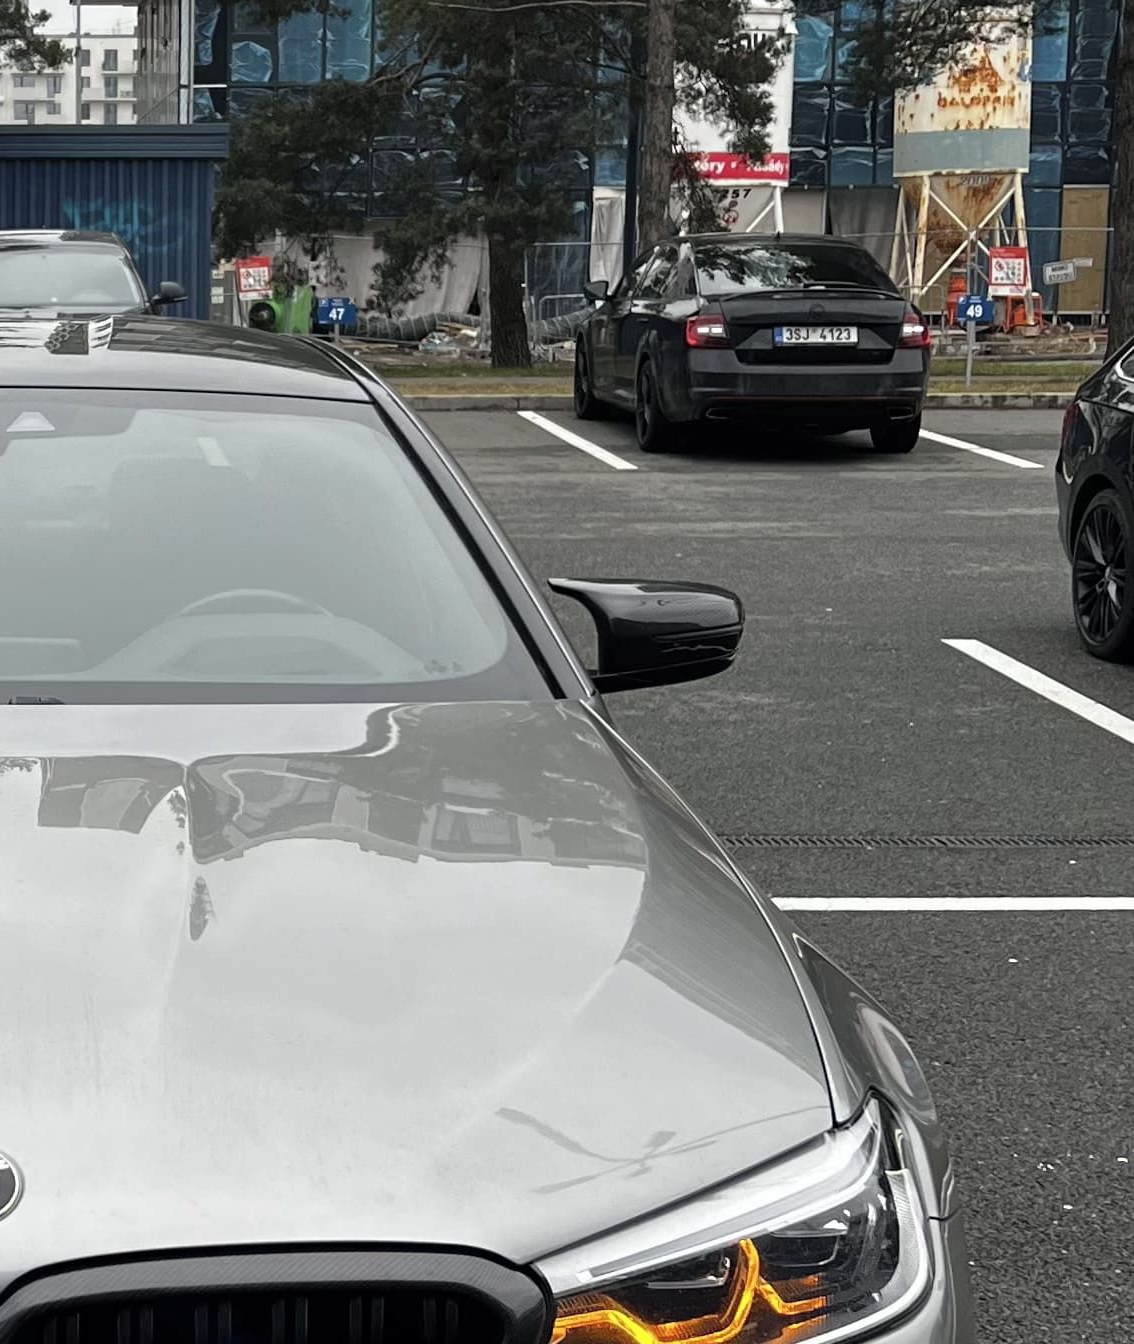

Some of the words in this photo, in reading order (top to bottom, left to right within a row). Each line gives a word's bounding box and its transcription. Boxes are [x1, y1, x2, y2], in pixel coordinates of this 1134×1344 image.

[328, 307, 345, 320] 47
[966, 304, 983, 318] 49
[786, 327, 810, 341] 3SJ
[819, 327, 851, 341] 4123
